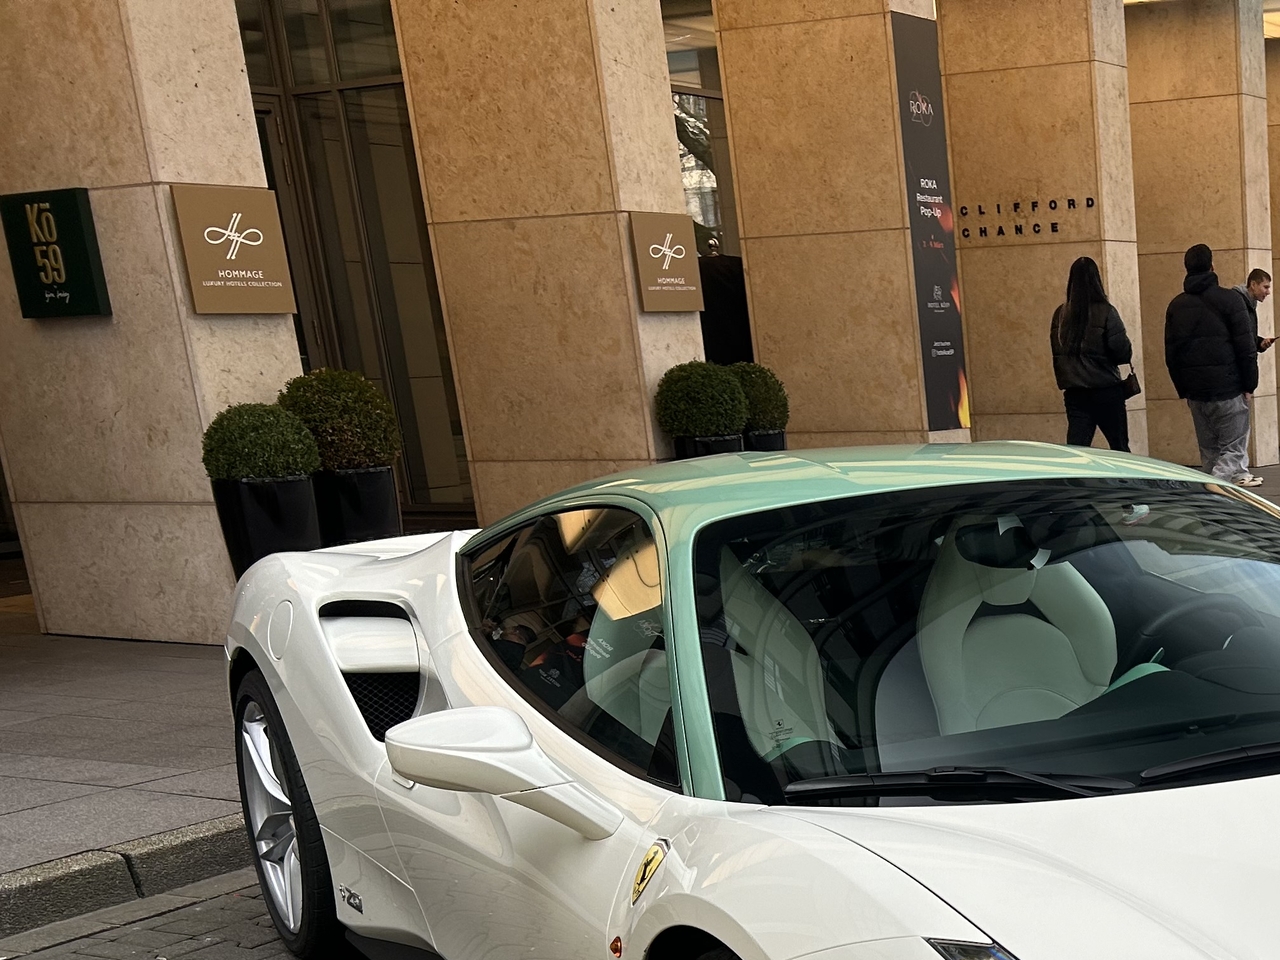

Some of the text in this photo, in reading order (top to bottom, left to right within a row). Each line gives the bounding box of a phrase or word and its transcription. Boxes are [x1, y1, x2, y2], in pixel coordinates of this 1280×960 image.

[909, 100, 934, 116] ROKA
[920, 178, 937, 190] ROKA
[916, 193, 943, 203] Restaurant
[920, 206, 942, 219] Pop-Up
[960, 197, 1095, 216] CLIFFORD
[962, 222, 1059, 239] CHANCE
[33, 244, 66, 284] 59
[217, 269, 264, 279] HOMMAGE
